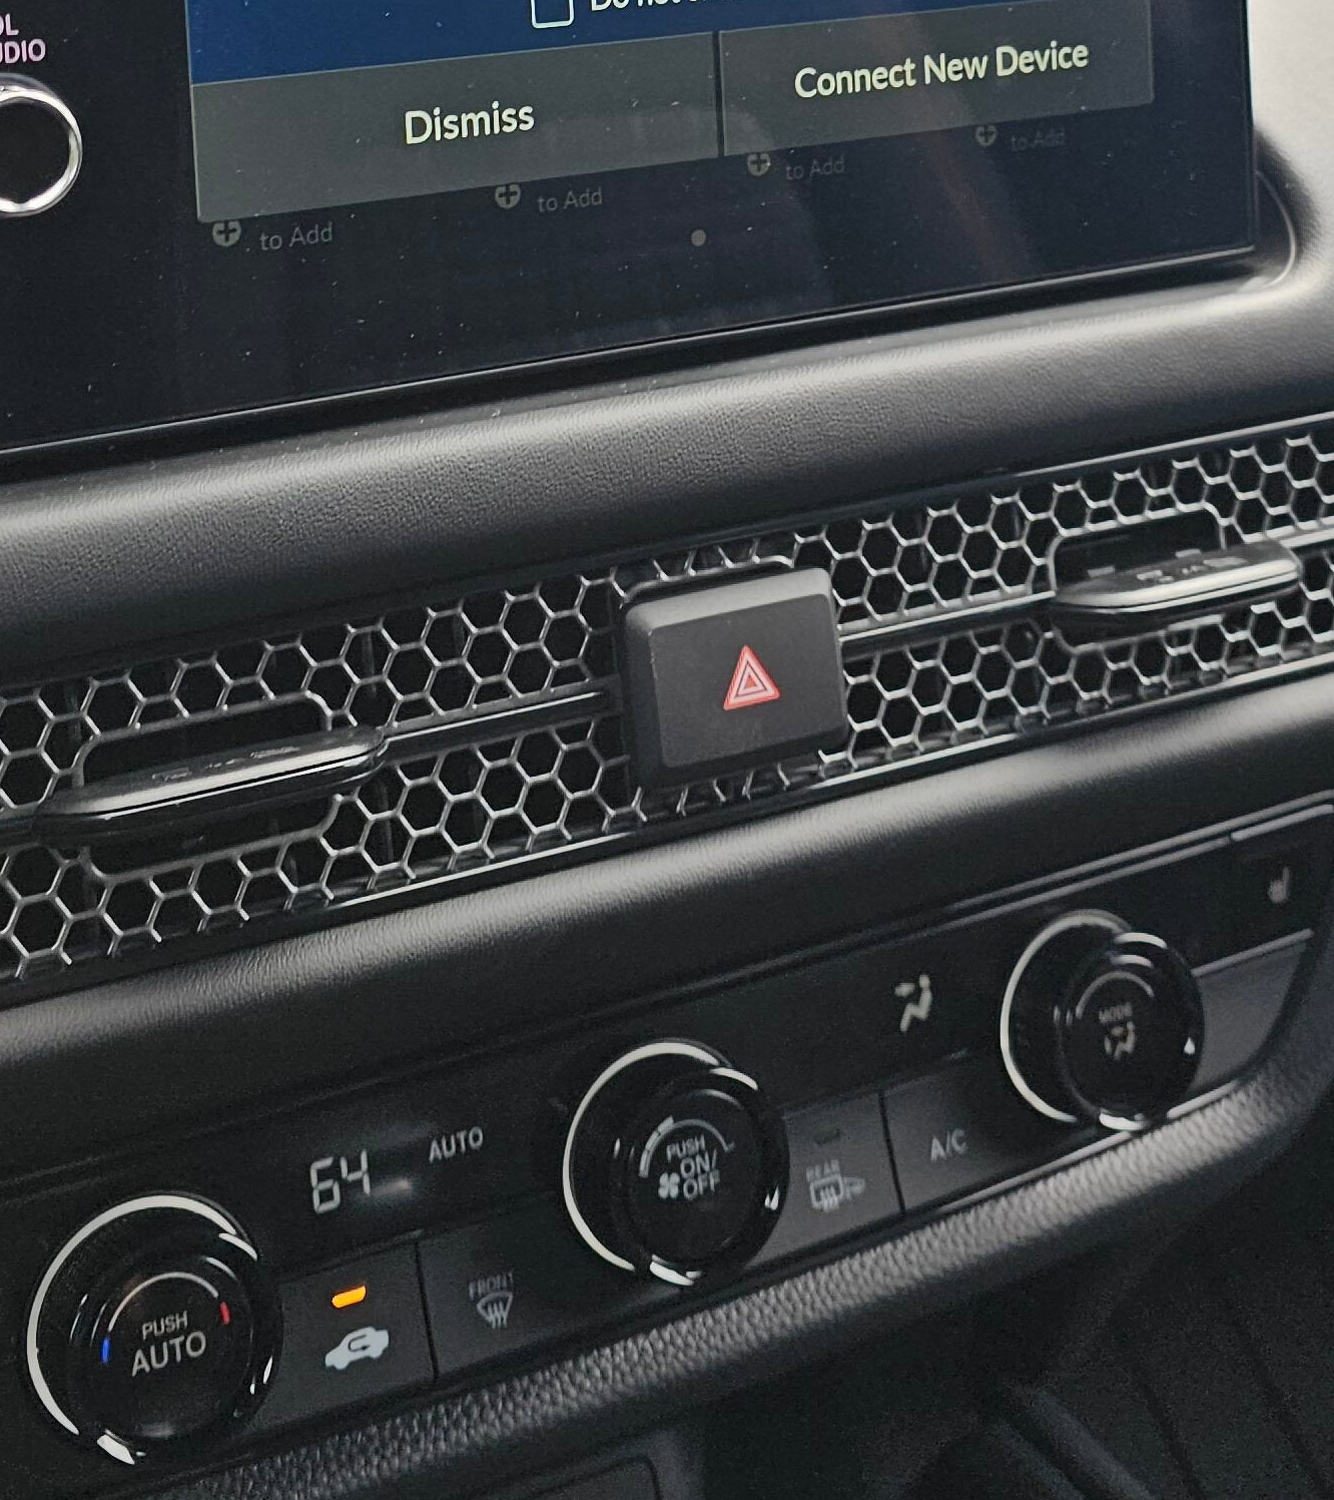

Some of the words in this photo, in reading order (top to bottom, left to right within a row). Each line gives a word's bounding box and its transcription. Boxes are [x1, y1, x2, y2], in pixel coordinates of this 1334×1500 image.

[794, 57, 917, 99] Connect
[924, 53, 989, 84] New
[996, 40, 1089, 77] Device
[405, 100, 535, 145] Dismiss
[786, 163, 805, 181] to
[809, 154, 845, 176] Add
[537, 195, 559, 213] to
[562, 187, 604, 210] Add
[260, 232, 283, 252] to
[289, 221, 334, 248] Add
[429, 1126, 484, 1164] AUTO
[667, 1134, 706, 1161] PUSH
[931, 1129, 967, 1163] A/C
[679, 1150, 718, 1179] ON/
[310, 1150, 371, 1214] 64
[683, 1170, 720, 1201] OFF
[142, 1310, 188, 1340] PUSH
[132, 1331, 206, 1377] AUTO
